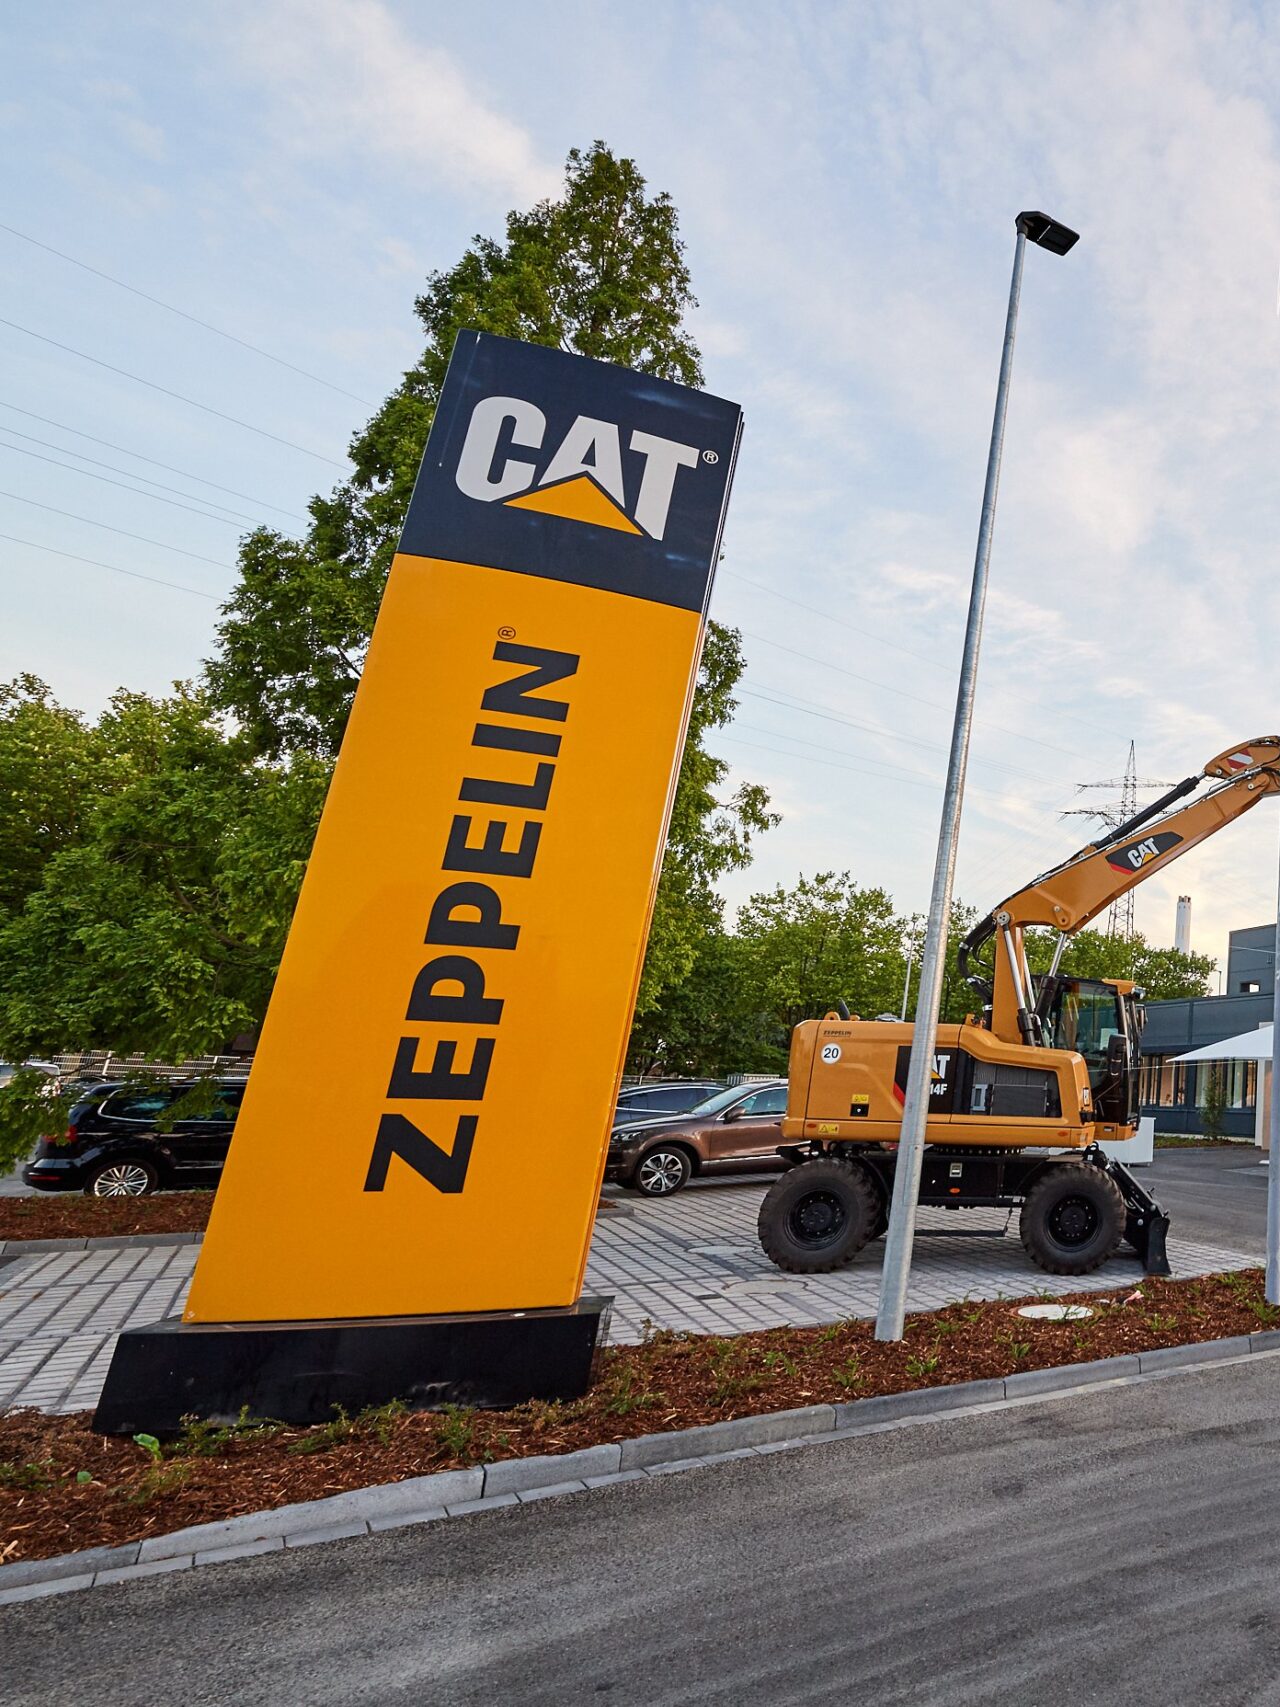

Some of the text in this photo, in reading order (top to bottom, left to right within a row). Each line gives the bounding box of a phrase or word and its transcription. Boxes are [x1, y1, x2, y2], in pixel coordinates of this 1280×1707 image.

[1127, 837, 1160, 868] CAT
[363, 640, 581, 1194] ZEPPELIN
[823, 1047, 840, 1059] 20
[929, 1083, 948, 1096] 14F
